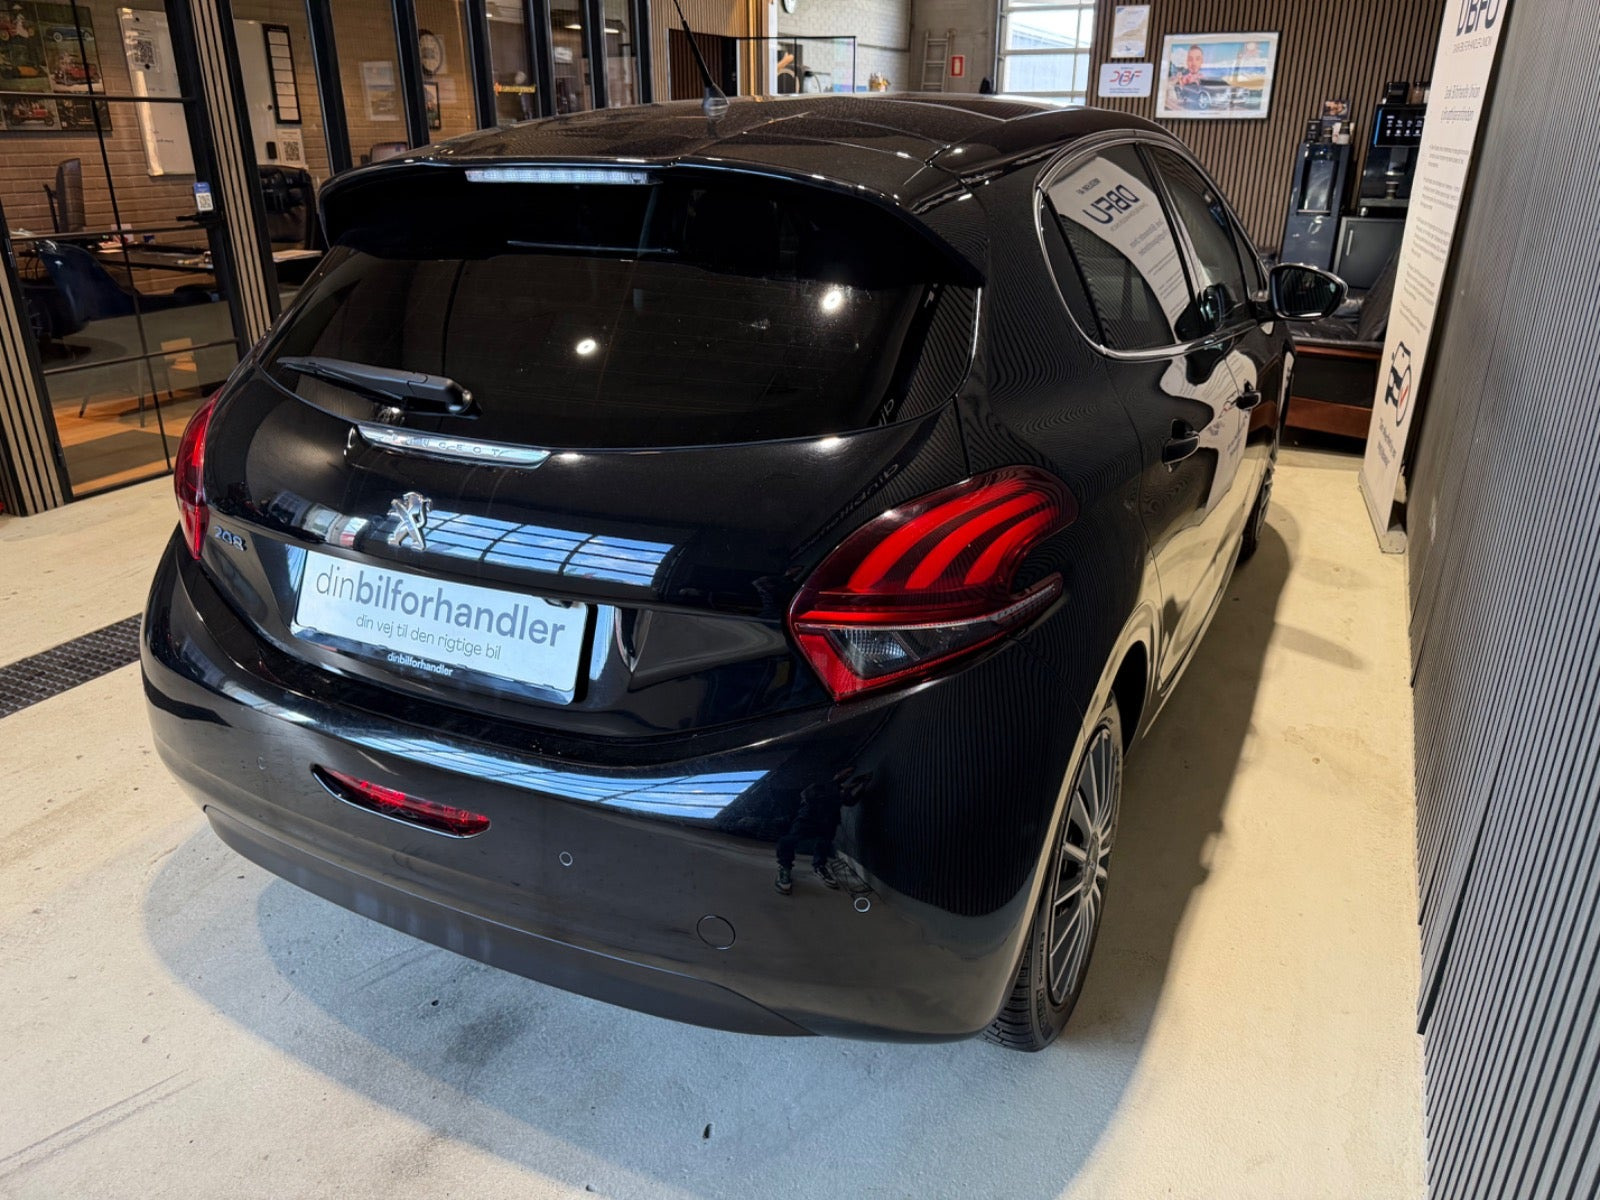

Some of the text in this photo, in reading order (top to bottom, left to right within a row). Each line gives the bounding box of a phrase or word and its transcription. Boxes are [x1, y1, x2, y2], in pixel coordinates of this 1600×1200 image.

[213, 525, 245, 551] 208
[316, 564, 565, 647] dinbilforhandler
[356, 614, 502, 661] din vej til den rigtige bil
[387, 651, 454, 676] dinbilforhandler
